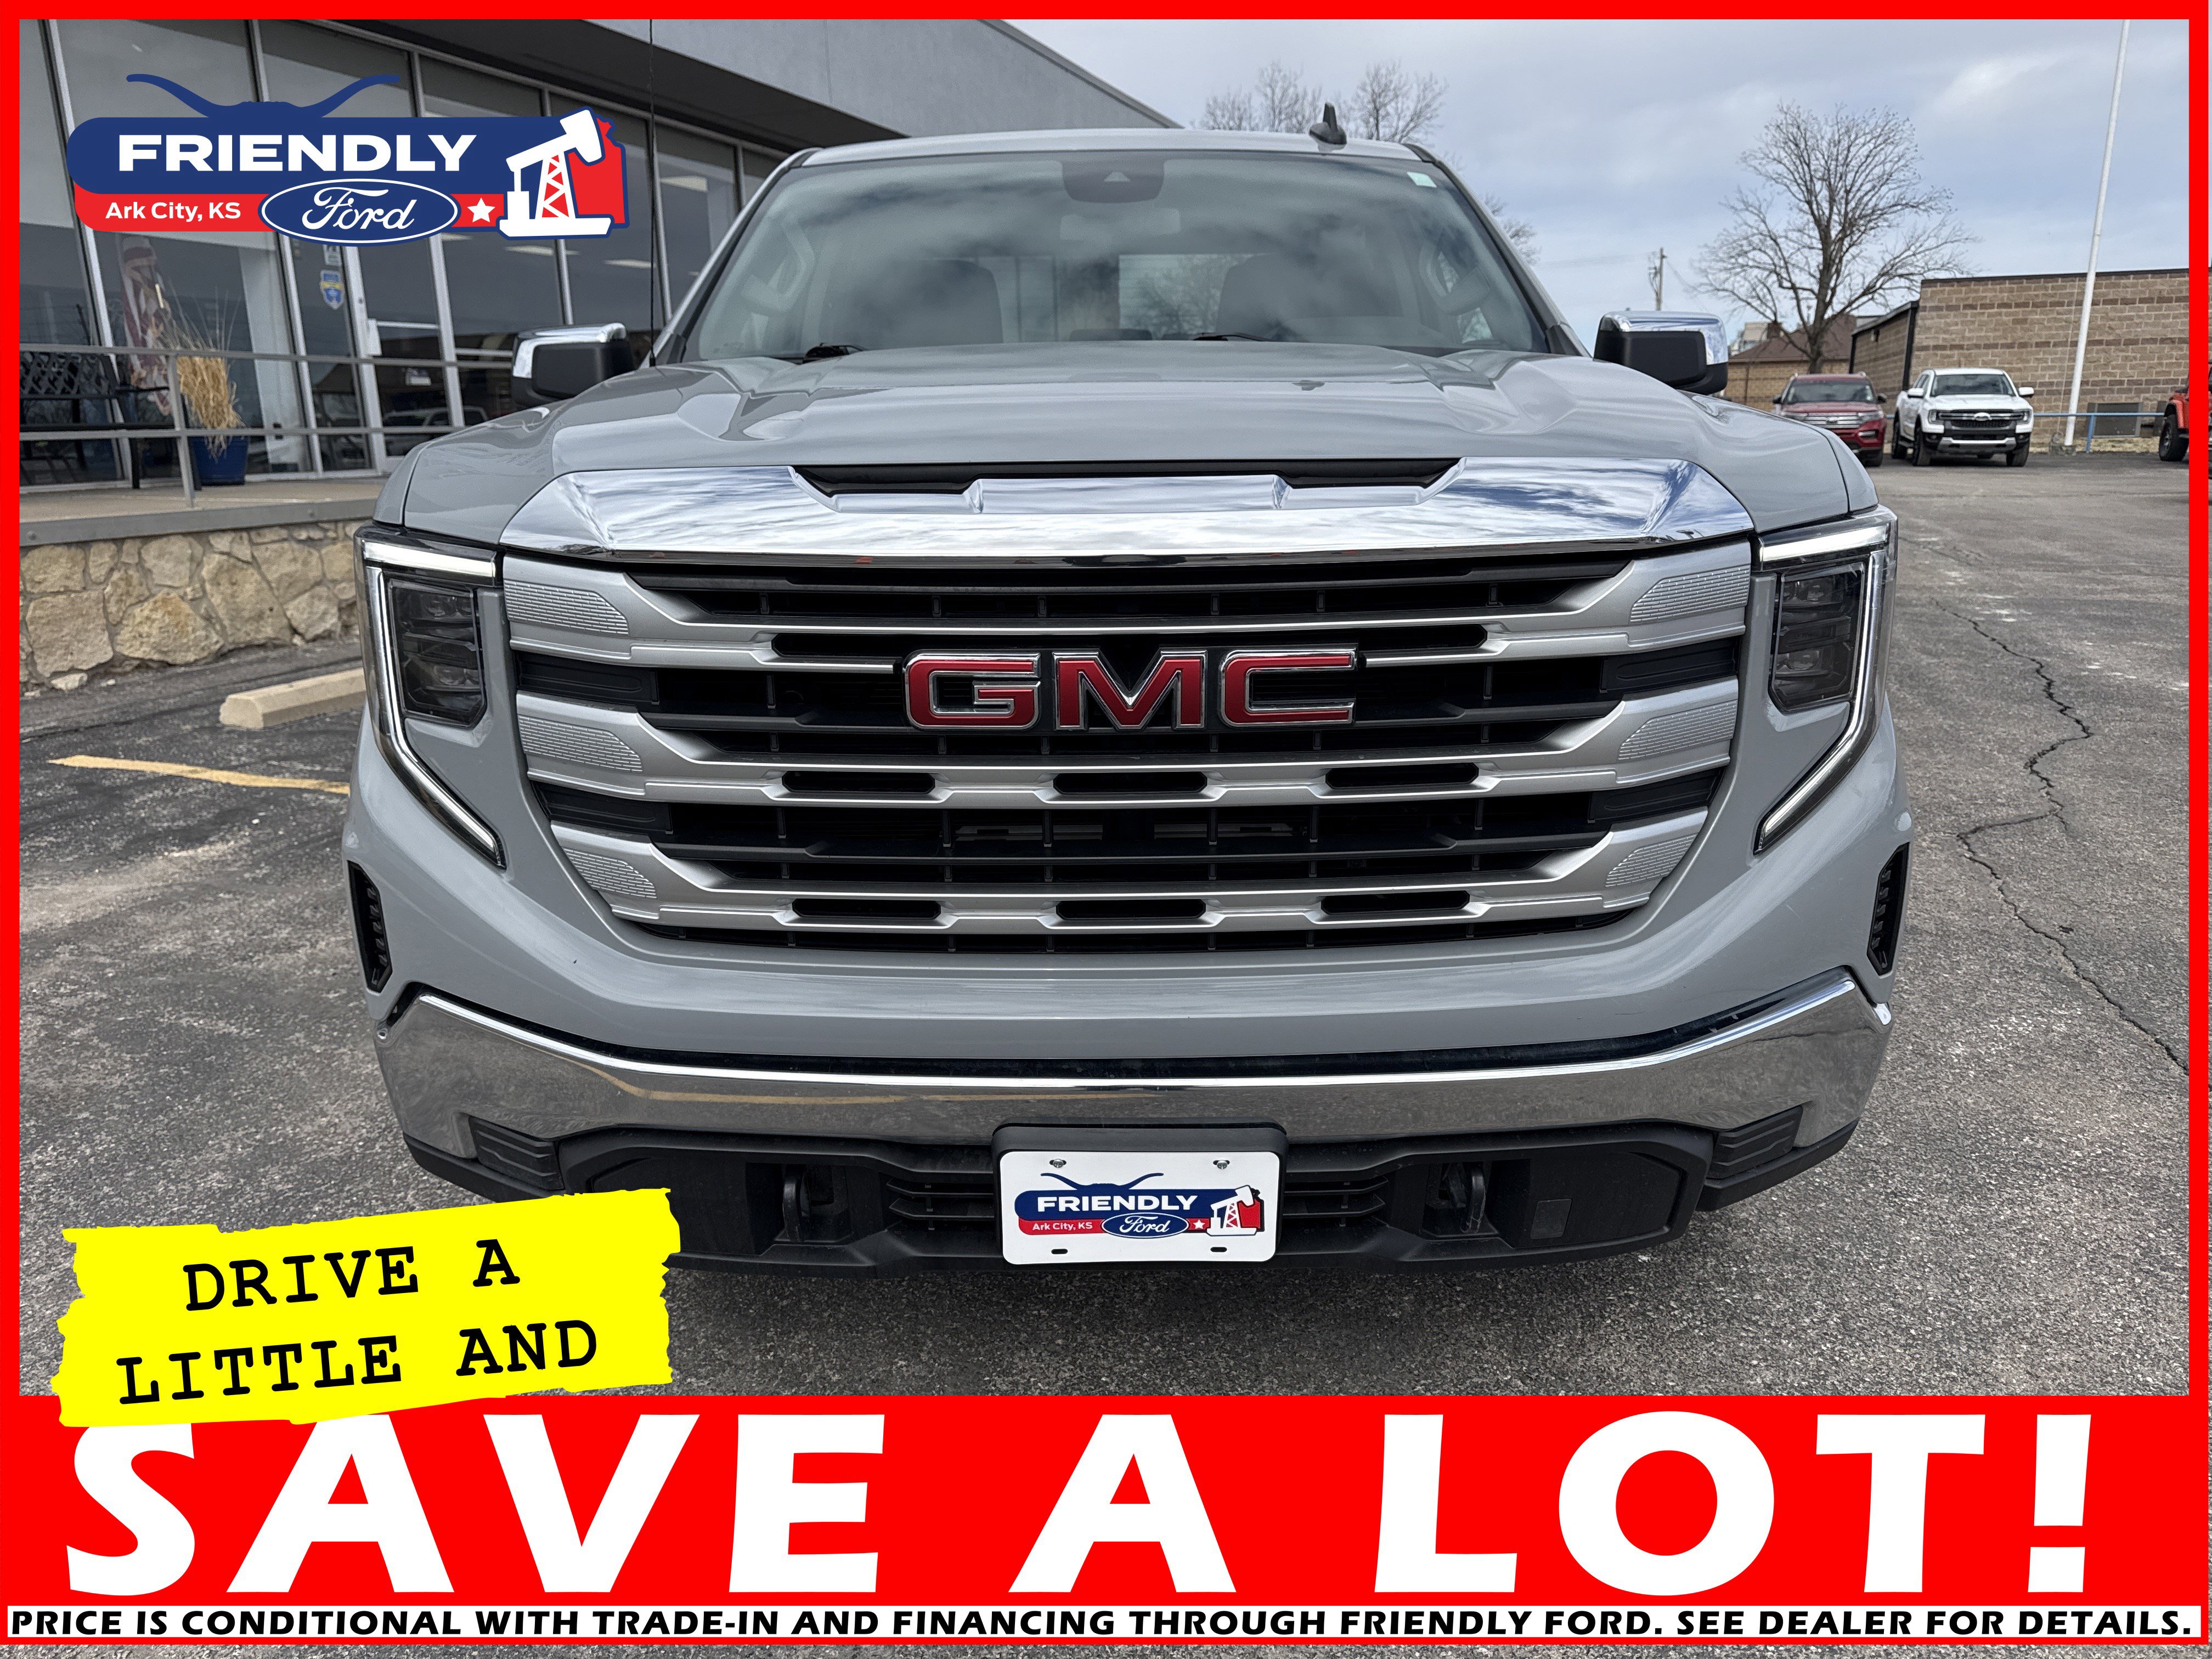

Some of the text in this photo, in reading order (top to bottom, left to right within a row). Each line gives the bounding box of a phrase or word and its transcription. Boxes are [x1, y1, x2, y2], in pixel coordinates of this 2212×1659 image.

[903, 647, 1356, 731] GMC
[1037, 1195, 1198, 1212] FRIENDLY
[1052, 1222, 1076, 1231] City,
[1119, 1215, 1171, 1233] Ford
